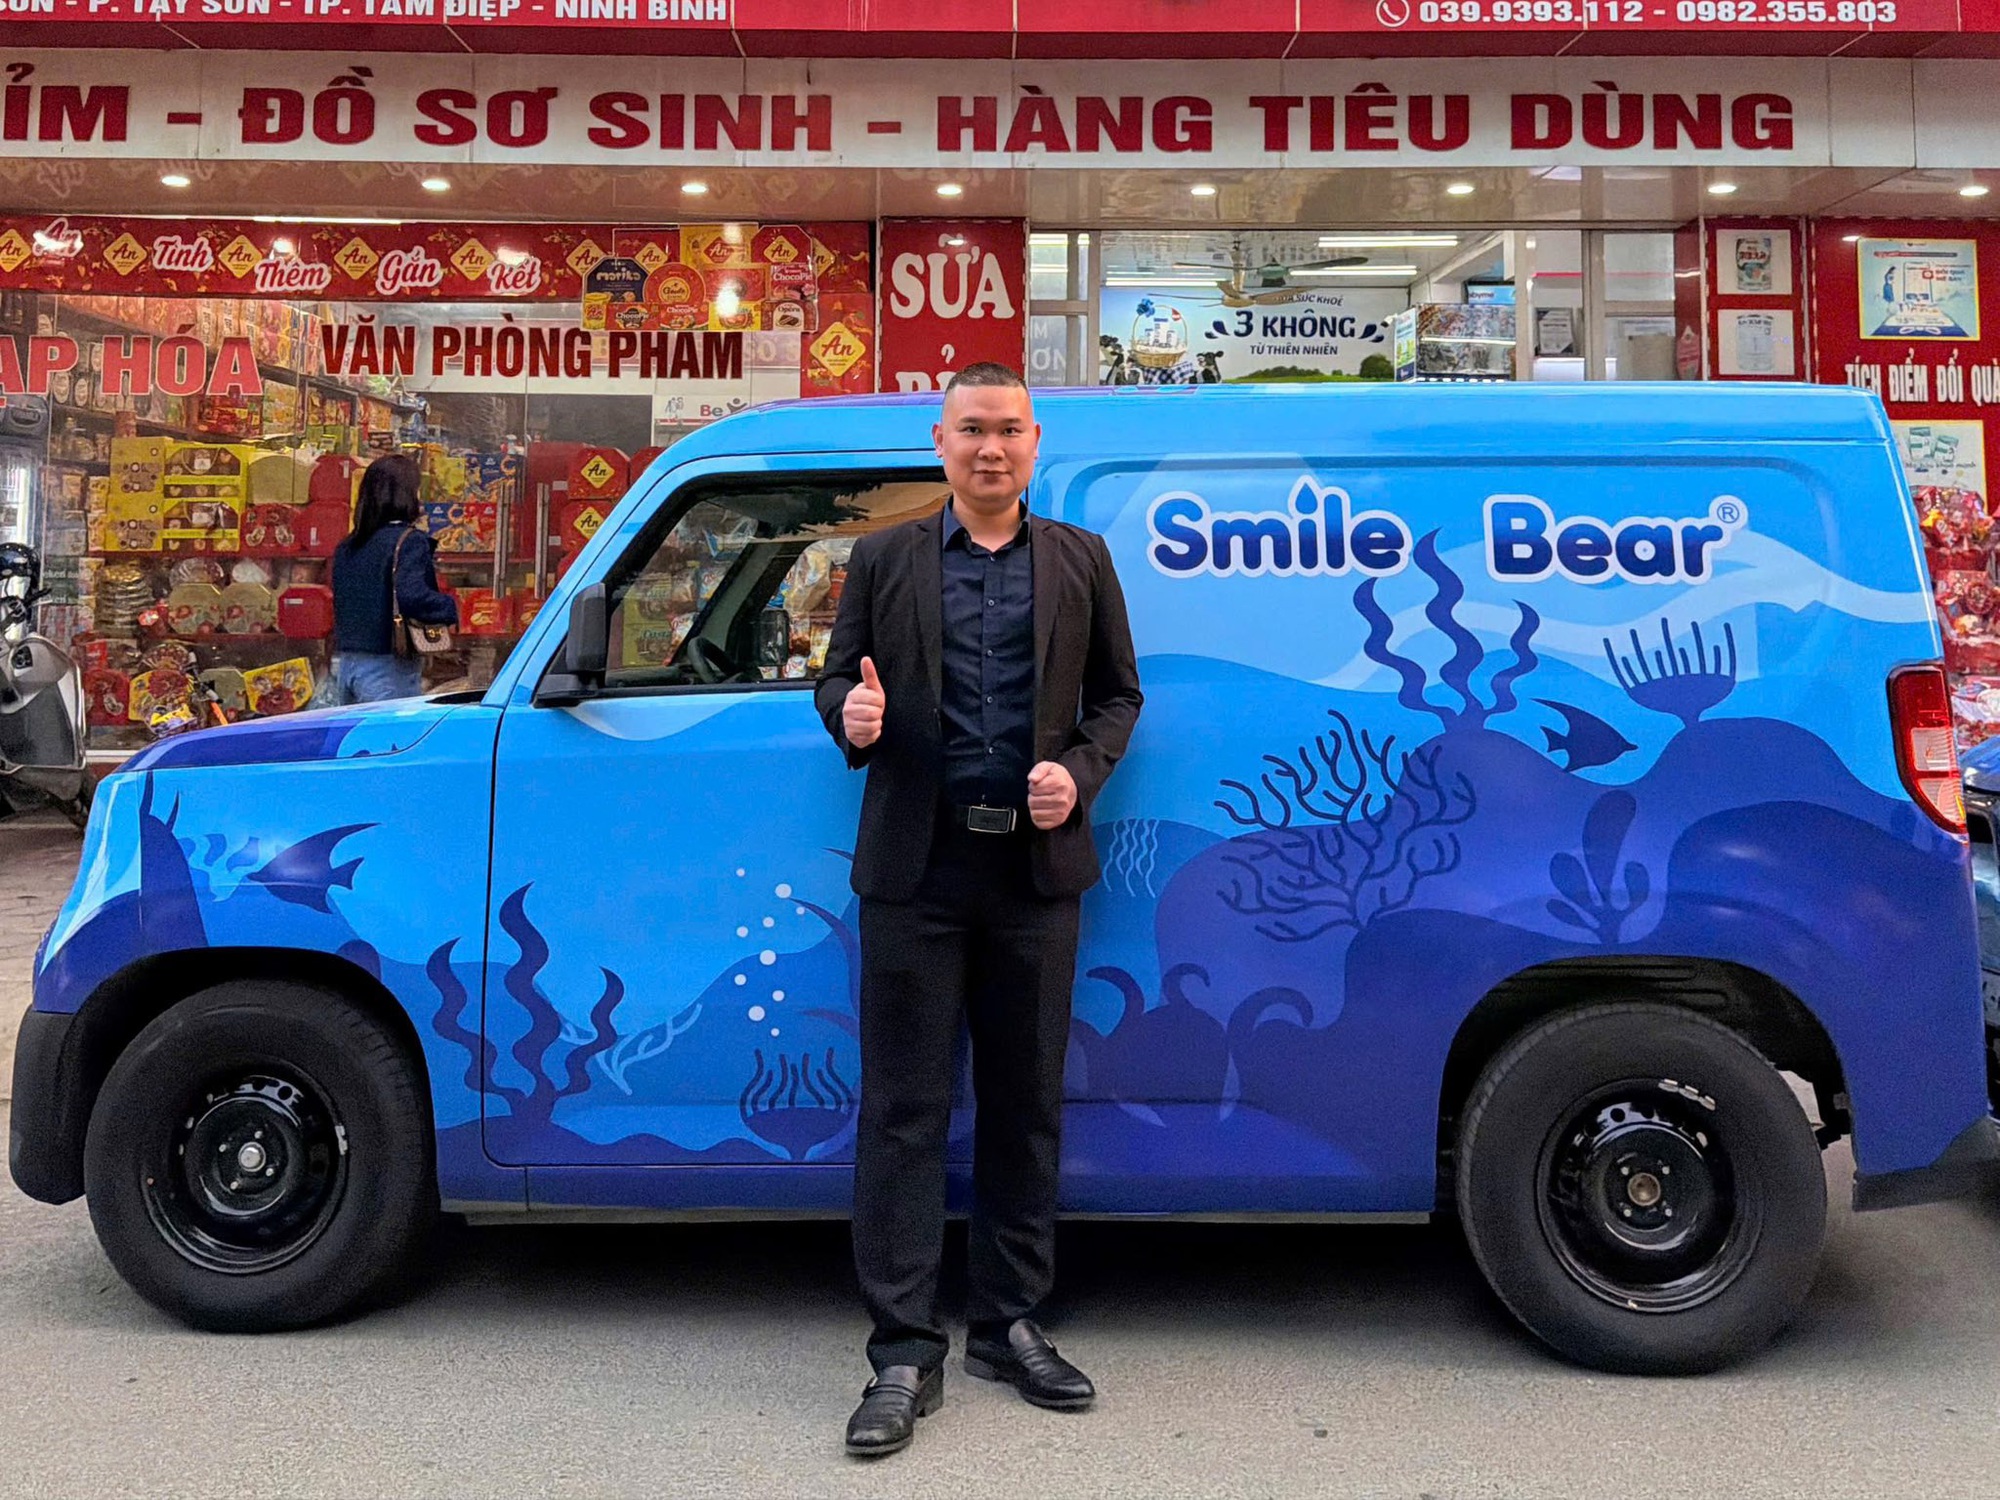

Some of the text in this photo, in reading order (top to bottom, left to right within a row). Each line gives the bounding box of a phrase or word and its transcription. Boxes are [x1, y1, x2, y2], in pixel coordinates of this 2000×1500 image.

[1419, 1, 1644, 22] 039.9393.112
[1676, 1, 1897, 22] 0982.355.803
[238, 66, 375, 145] ĐỒ
[414, 86, 558, 147] SƠ
[587, 91, 832, 151] SINH
[937, 84, 1213, 152] HÀNG
[1249, 82, 1470, 152] TIÊU
[1510, 80, 1793, 151] DÙNG
[112, 242, 138, 260] An
[228, 245, 254, 262] An
[343, 250, 370, 265] An
[460, 248, 486, 265] An
[771, 244, 791, 258] An
[254, 257, 332, 292] Thêm
[1233, 308, 1357, 338] 3 KHÔNG
[321, 314, 415, 376] VĂN
[432, 313, 592, 378] PHÒNG
[821, 335, 856, 357] An
[102, 323, 263, 396] HÓA
[1888, 347, 1928, 402] ĐIỂM
[1936, 348, 1964, 403] ĐỔI
[587, 463, 607, 477] An
[1152, 478, 1406, 572] Smile
